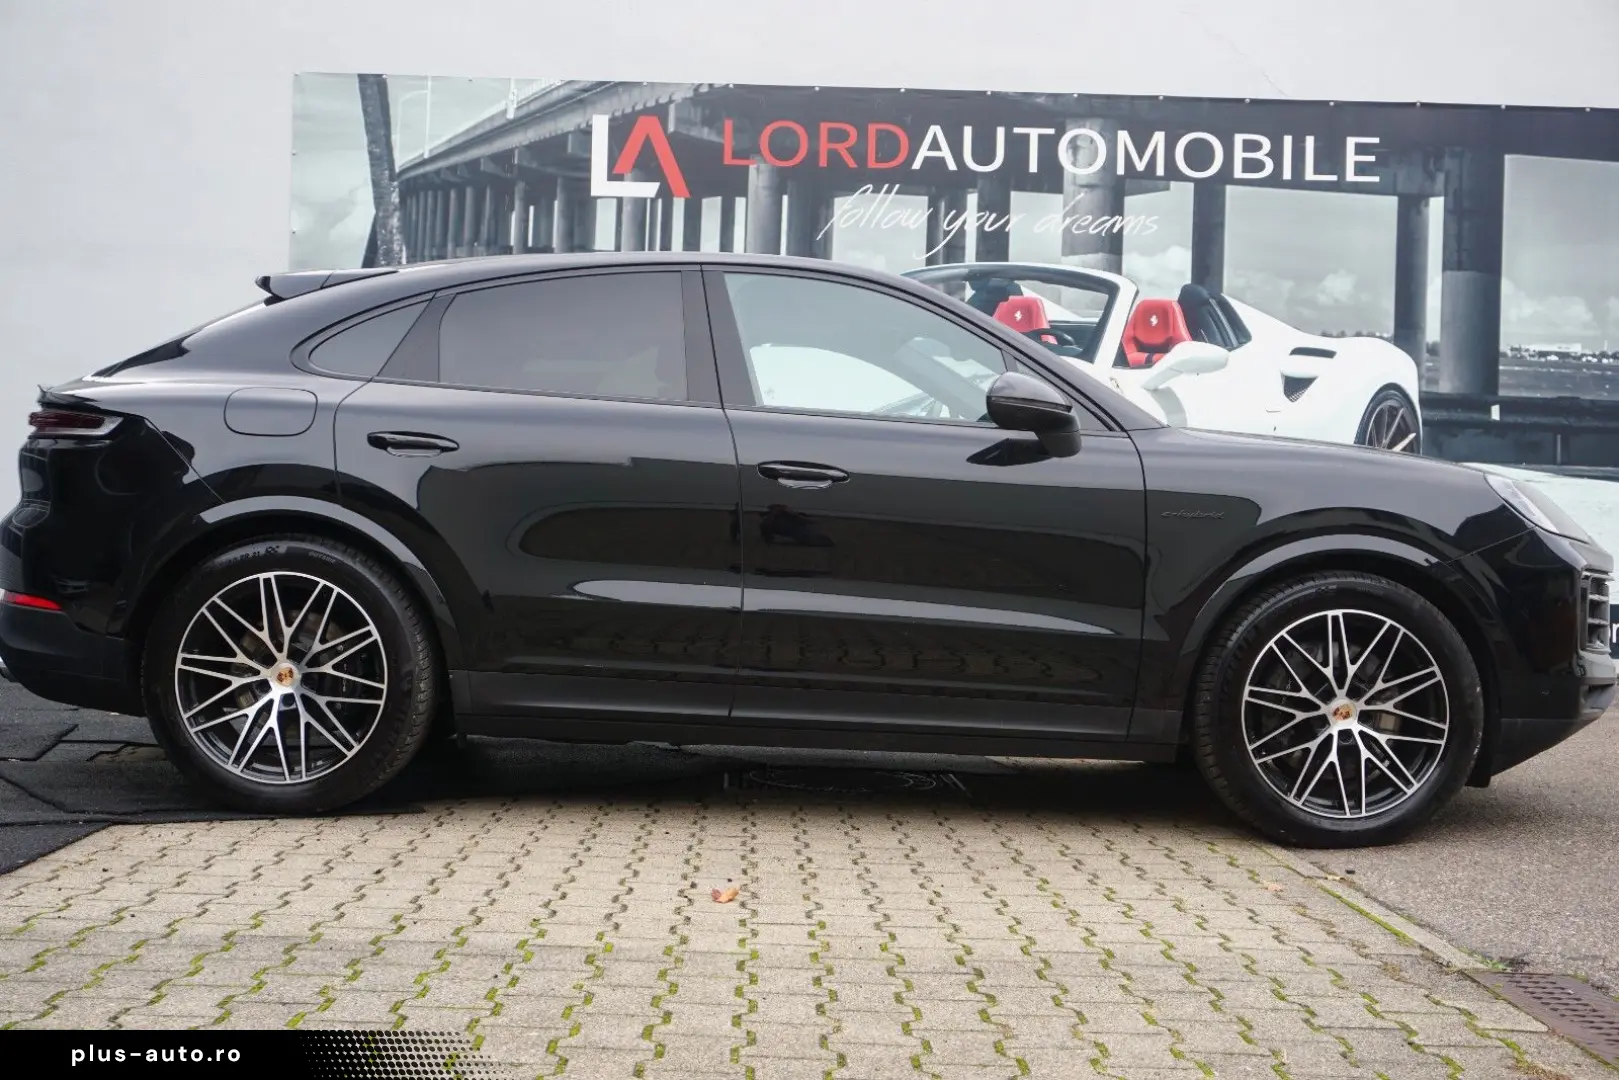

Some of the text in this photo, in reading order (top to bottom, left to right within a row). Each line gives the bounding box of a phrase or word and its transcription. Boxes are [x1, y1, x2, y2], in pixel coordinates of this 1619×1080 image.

[817, 184, 1160, 259] follow your dreams
